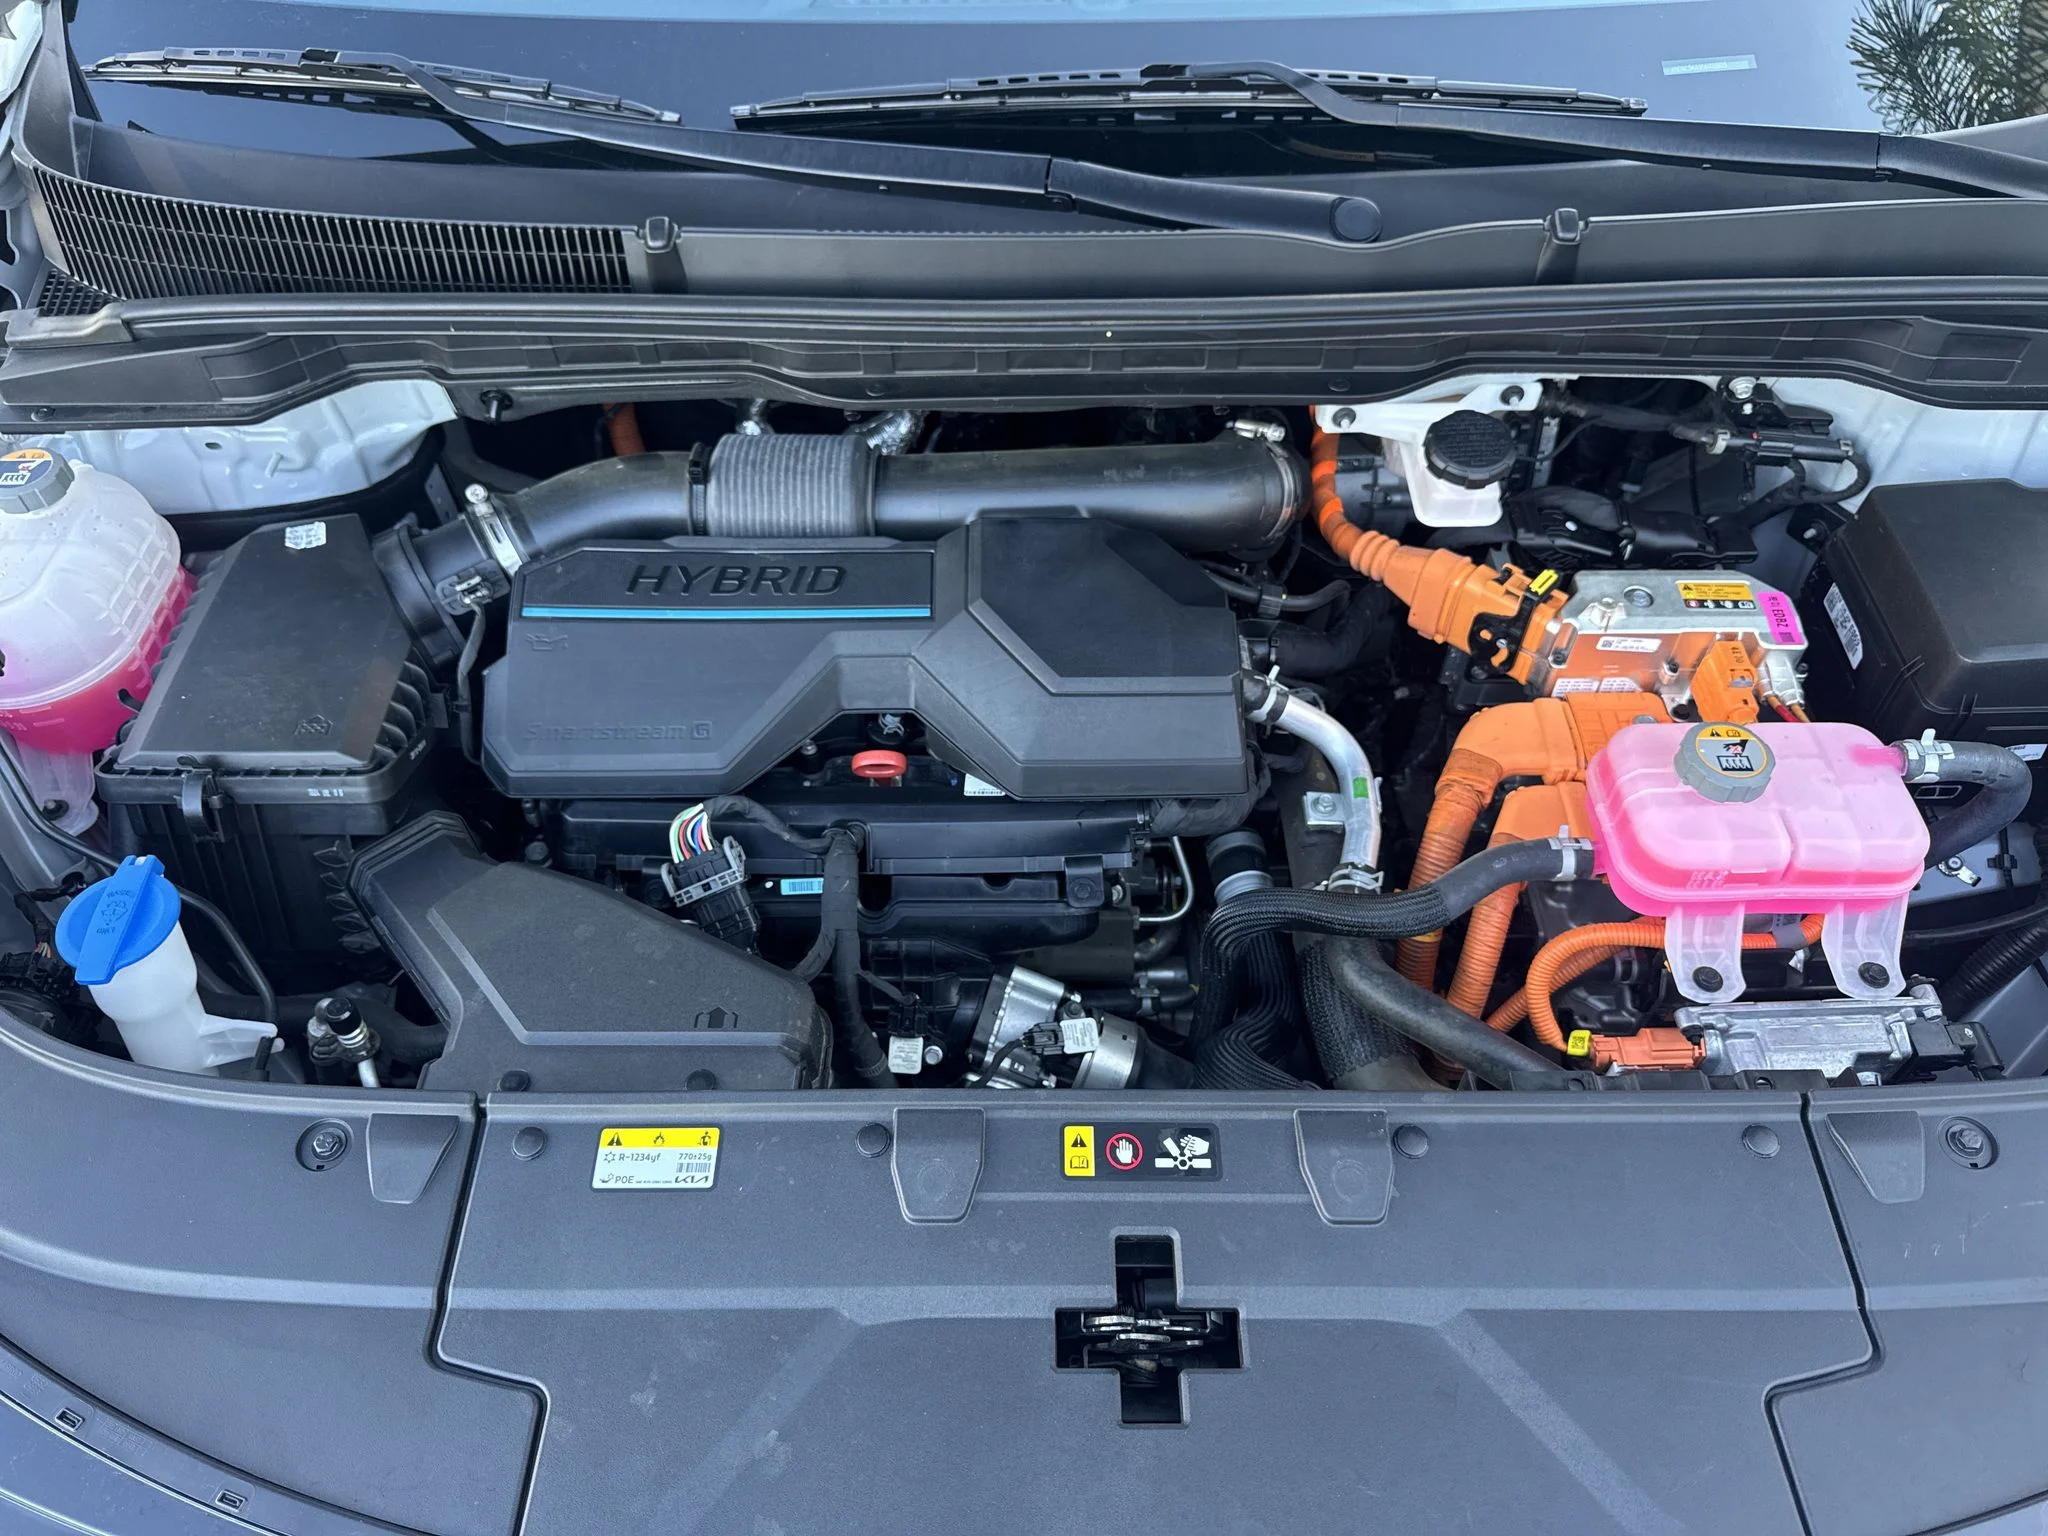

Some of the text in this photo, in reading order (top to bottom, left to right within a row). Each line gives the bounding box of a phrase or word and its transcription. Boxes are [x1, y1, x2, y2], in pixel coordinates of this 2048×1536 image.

[624, 565, 847, 596] HYBRID
[523, 720, 713, 741] Smartstream G
[618, 1152, 712, 1163] R-1234yf 770±25g
[614, 1175, 635, 1184] POE
[674, 1175, 709, 1184] KIA
